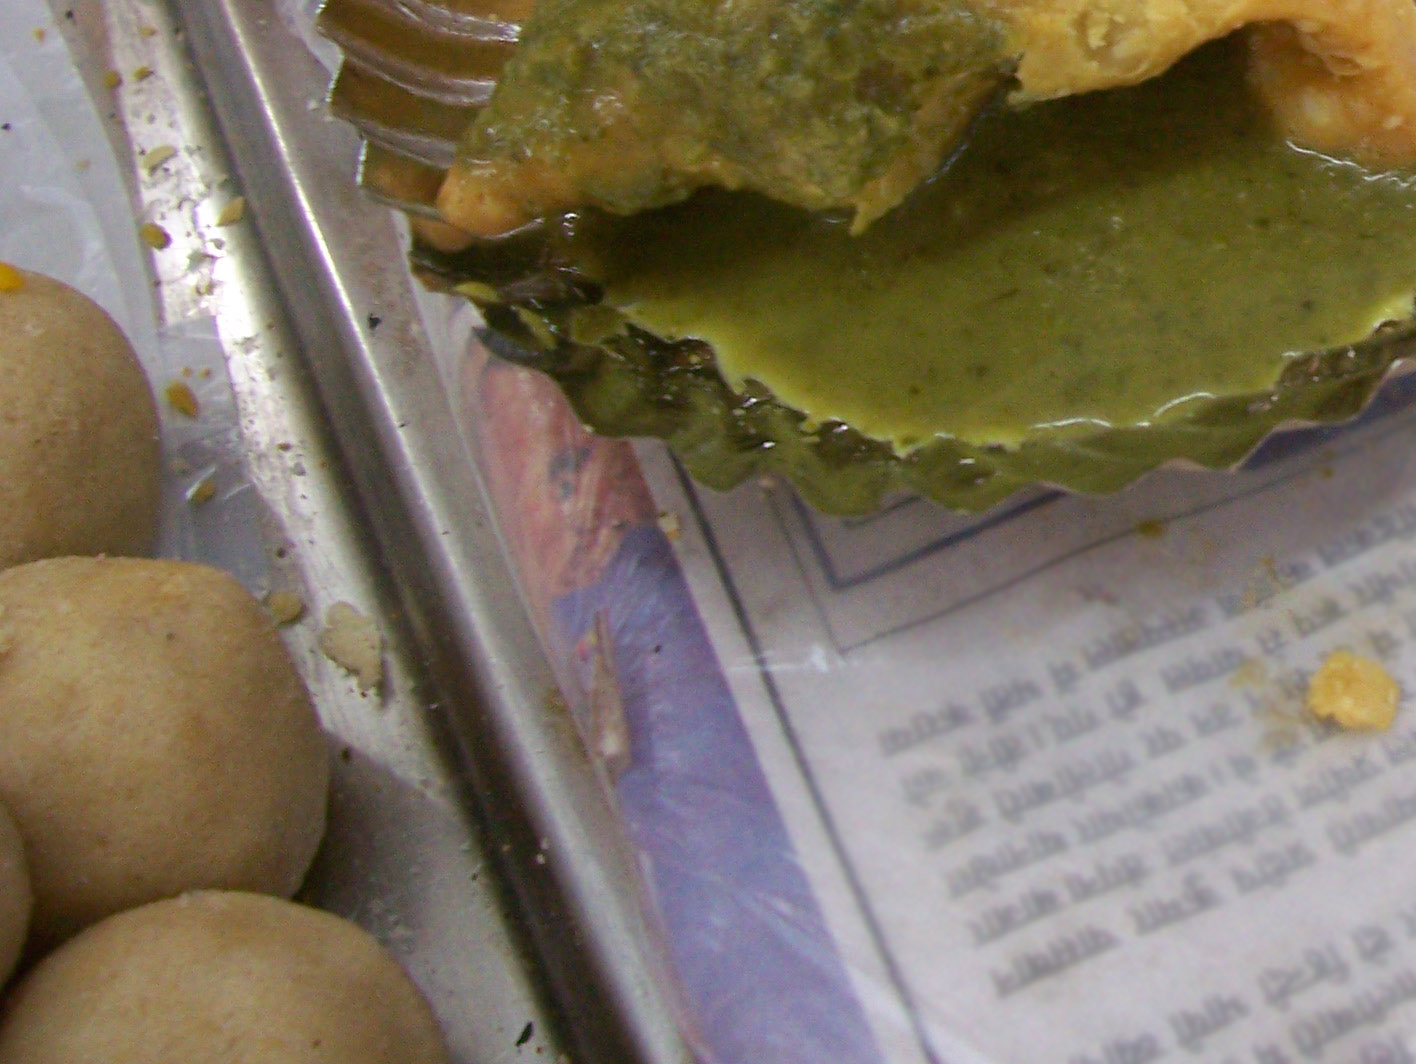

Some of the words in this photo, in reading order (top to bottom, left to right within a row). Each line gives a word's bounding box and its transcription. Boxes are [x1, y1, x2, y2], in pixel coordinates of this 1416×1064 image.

[1078, 595, 1211, 677] अस्पताल
[1157, 633, 1253, 699] घायल
[1046, 653, 1085, 697] में
[1100, 676, 1151, 728] हो
[872, 692, 976, 761] कराया
[1025, 694, 1102, 754] गए।
[1138, 718, 1187, 760] पर
[991, 736, 1141, 835] गोलीबारी
[1123, 868, 1221, 940] कुमार
[1228, 835, 1321, 905] प्रदीप
[986, 916, 1121, 999] पासवान
[1254, 939, 1354, 1018] हिन्दी
[1347, 918, 1399, 973] दो
[1162, 984, 1256, 1061] भाषी
